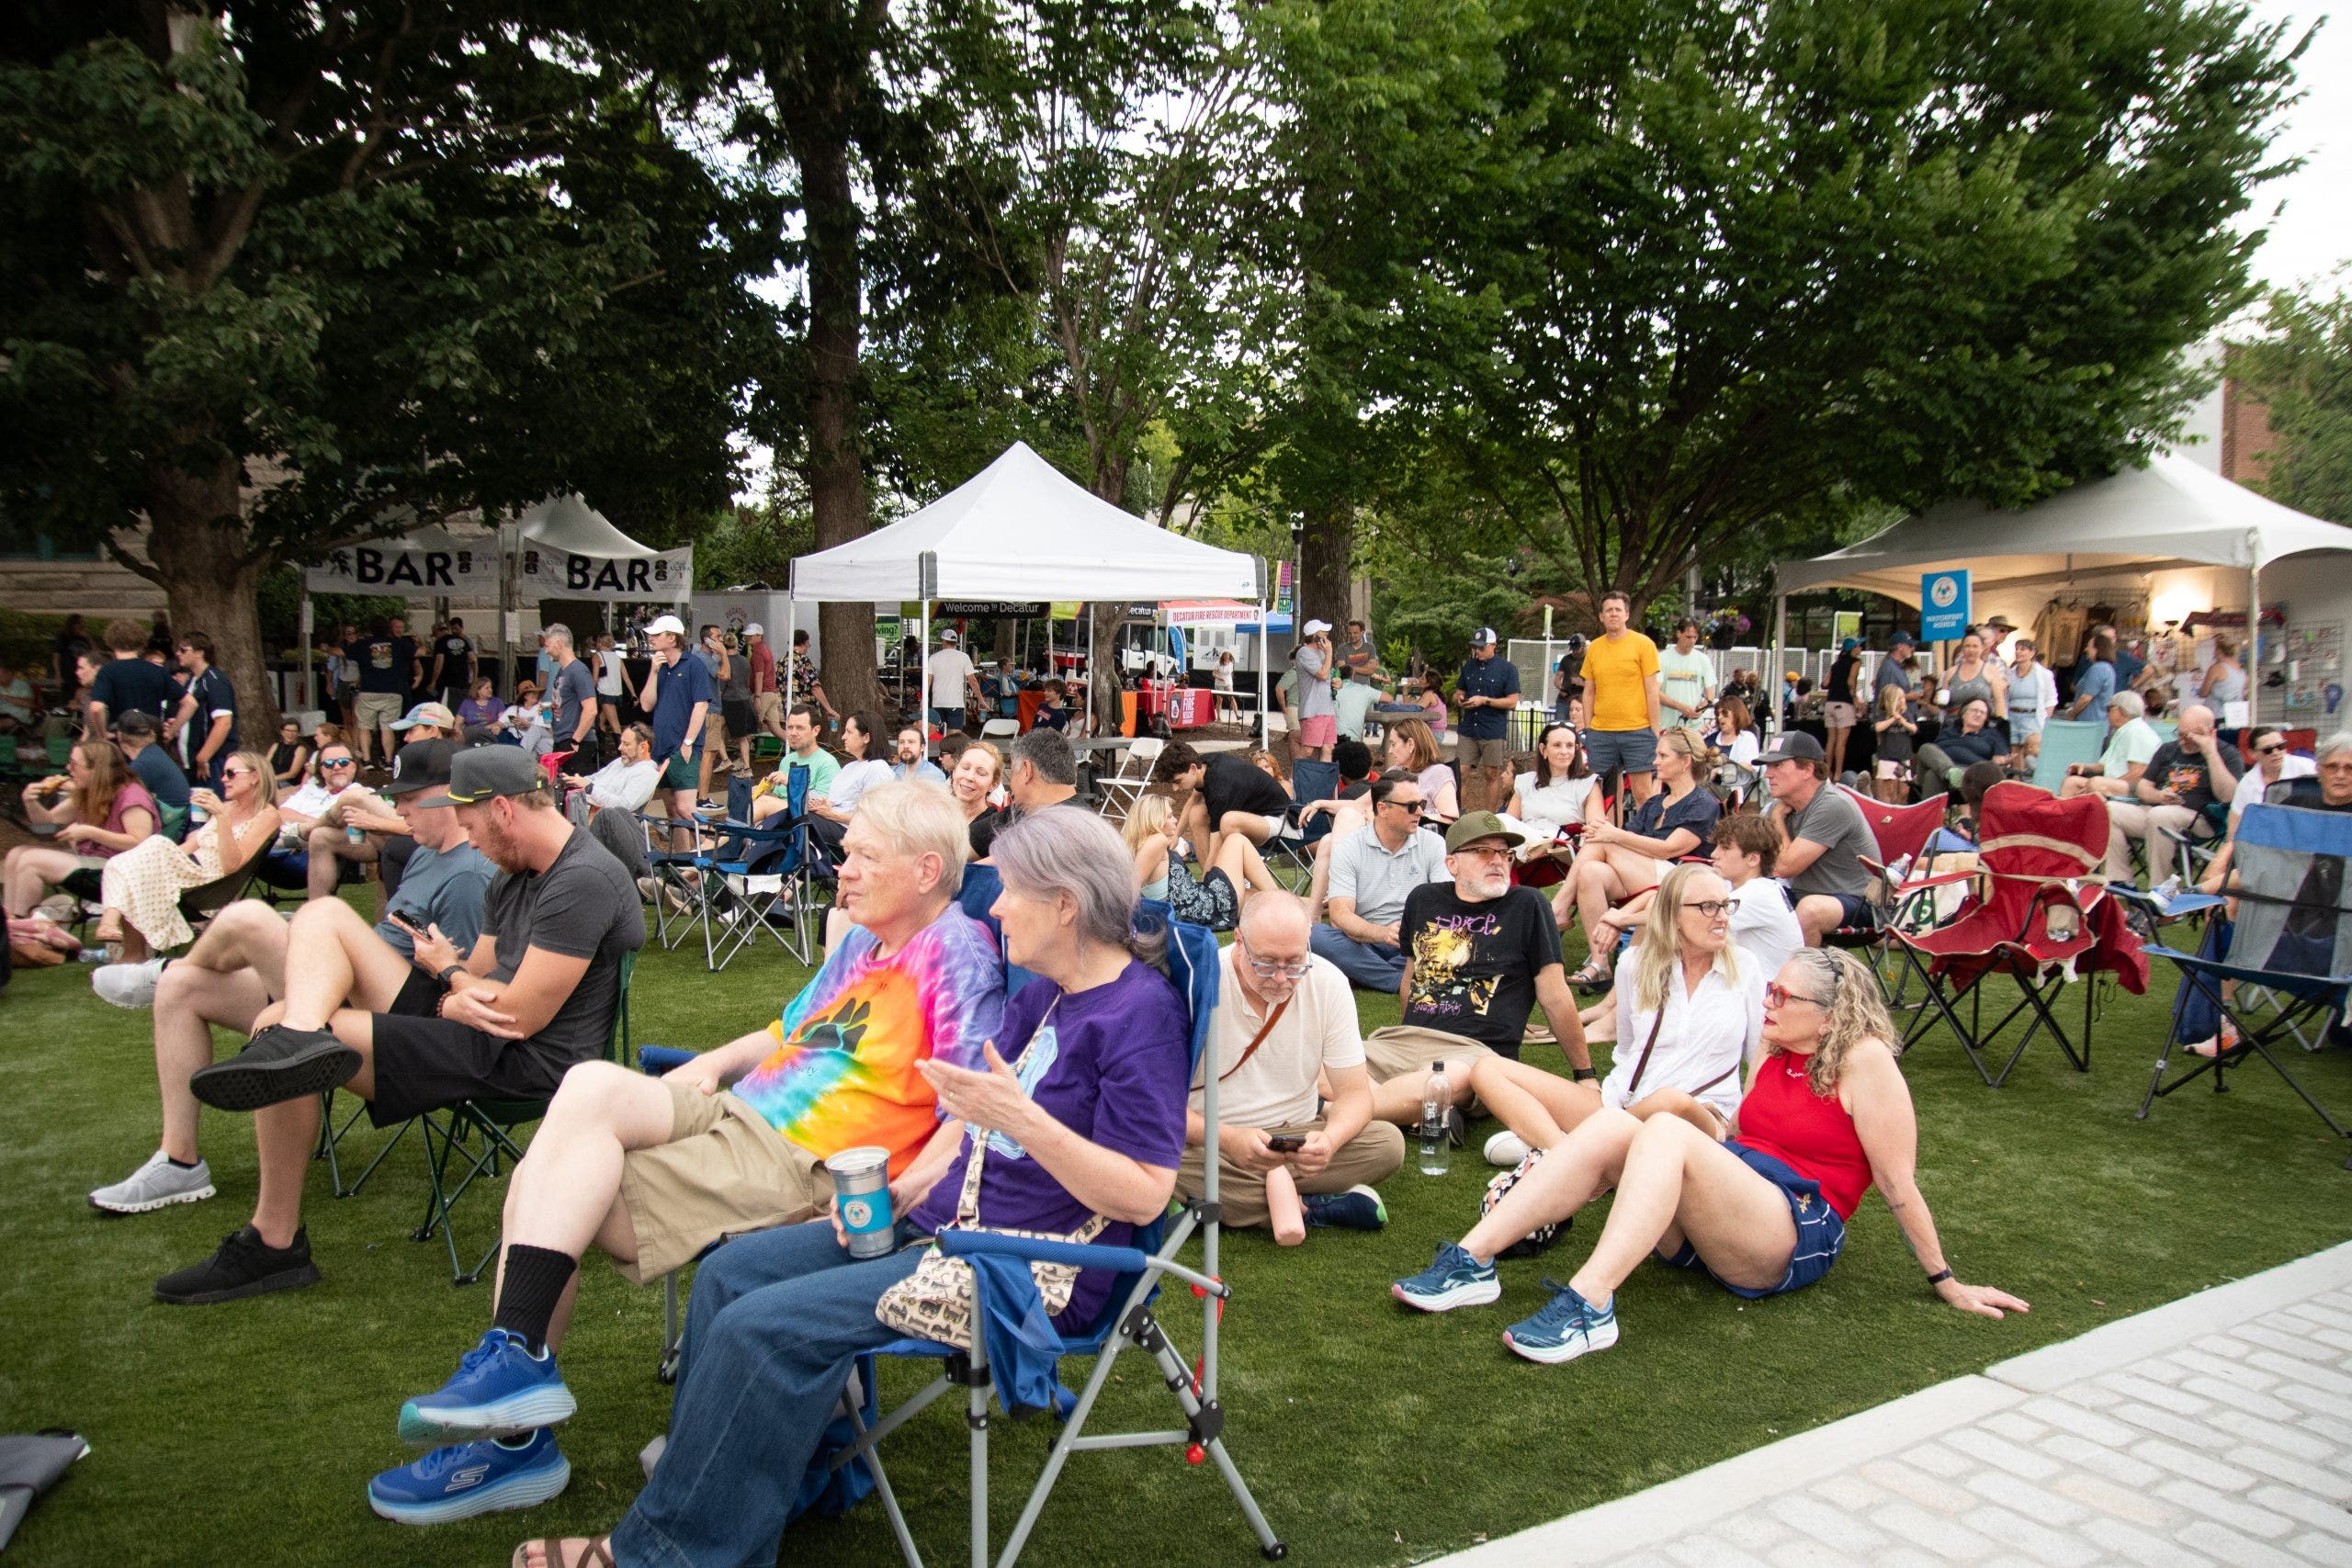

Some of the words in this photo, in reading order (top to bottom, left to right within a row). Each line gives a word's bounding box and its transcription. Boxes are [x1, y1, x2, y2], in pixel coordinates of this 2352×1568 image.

[356, 547, 456, 586] BAR
[567, 554, 653, 592] BAR
[944, 603, 989, 613] Welcome
[1000, 603, 1040, 613] Decatur
[1172, 611, 1194, 622] DECATUR
[1195, 611, 1205, 621] FIRE
[1206, 611, 1223, 621] RESCUE
[1224, 610, 1251, 620] DEPARTMENT
[875, 626, 899, 636] ving?
